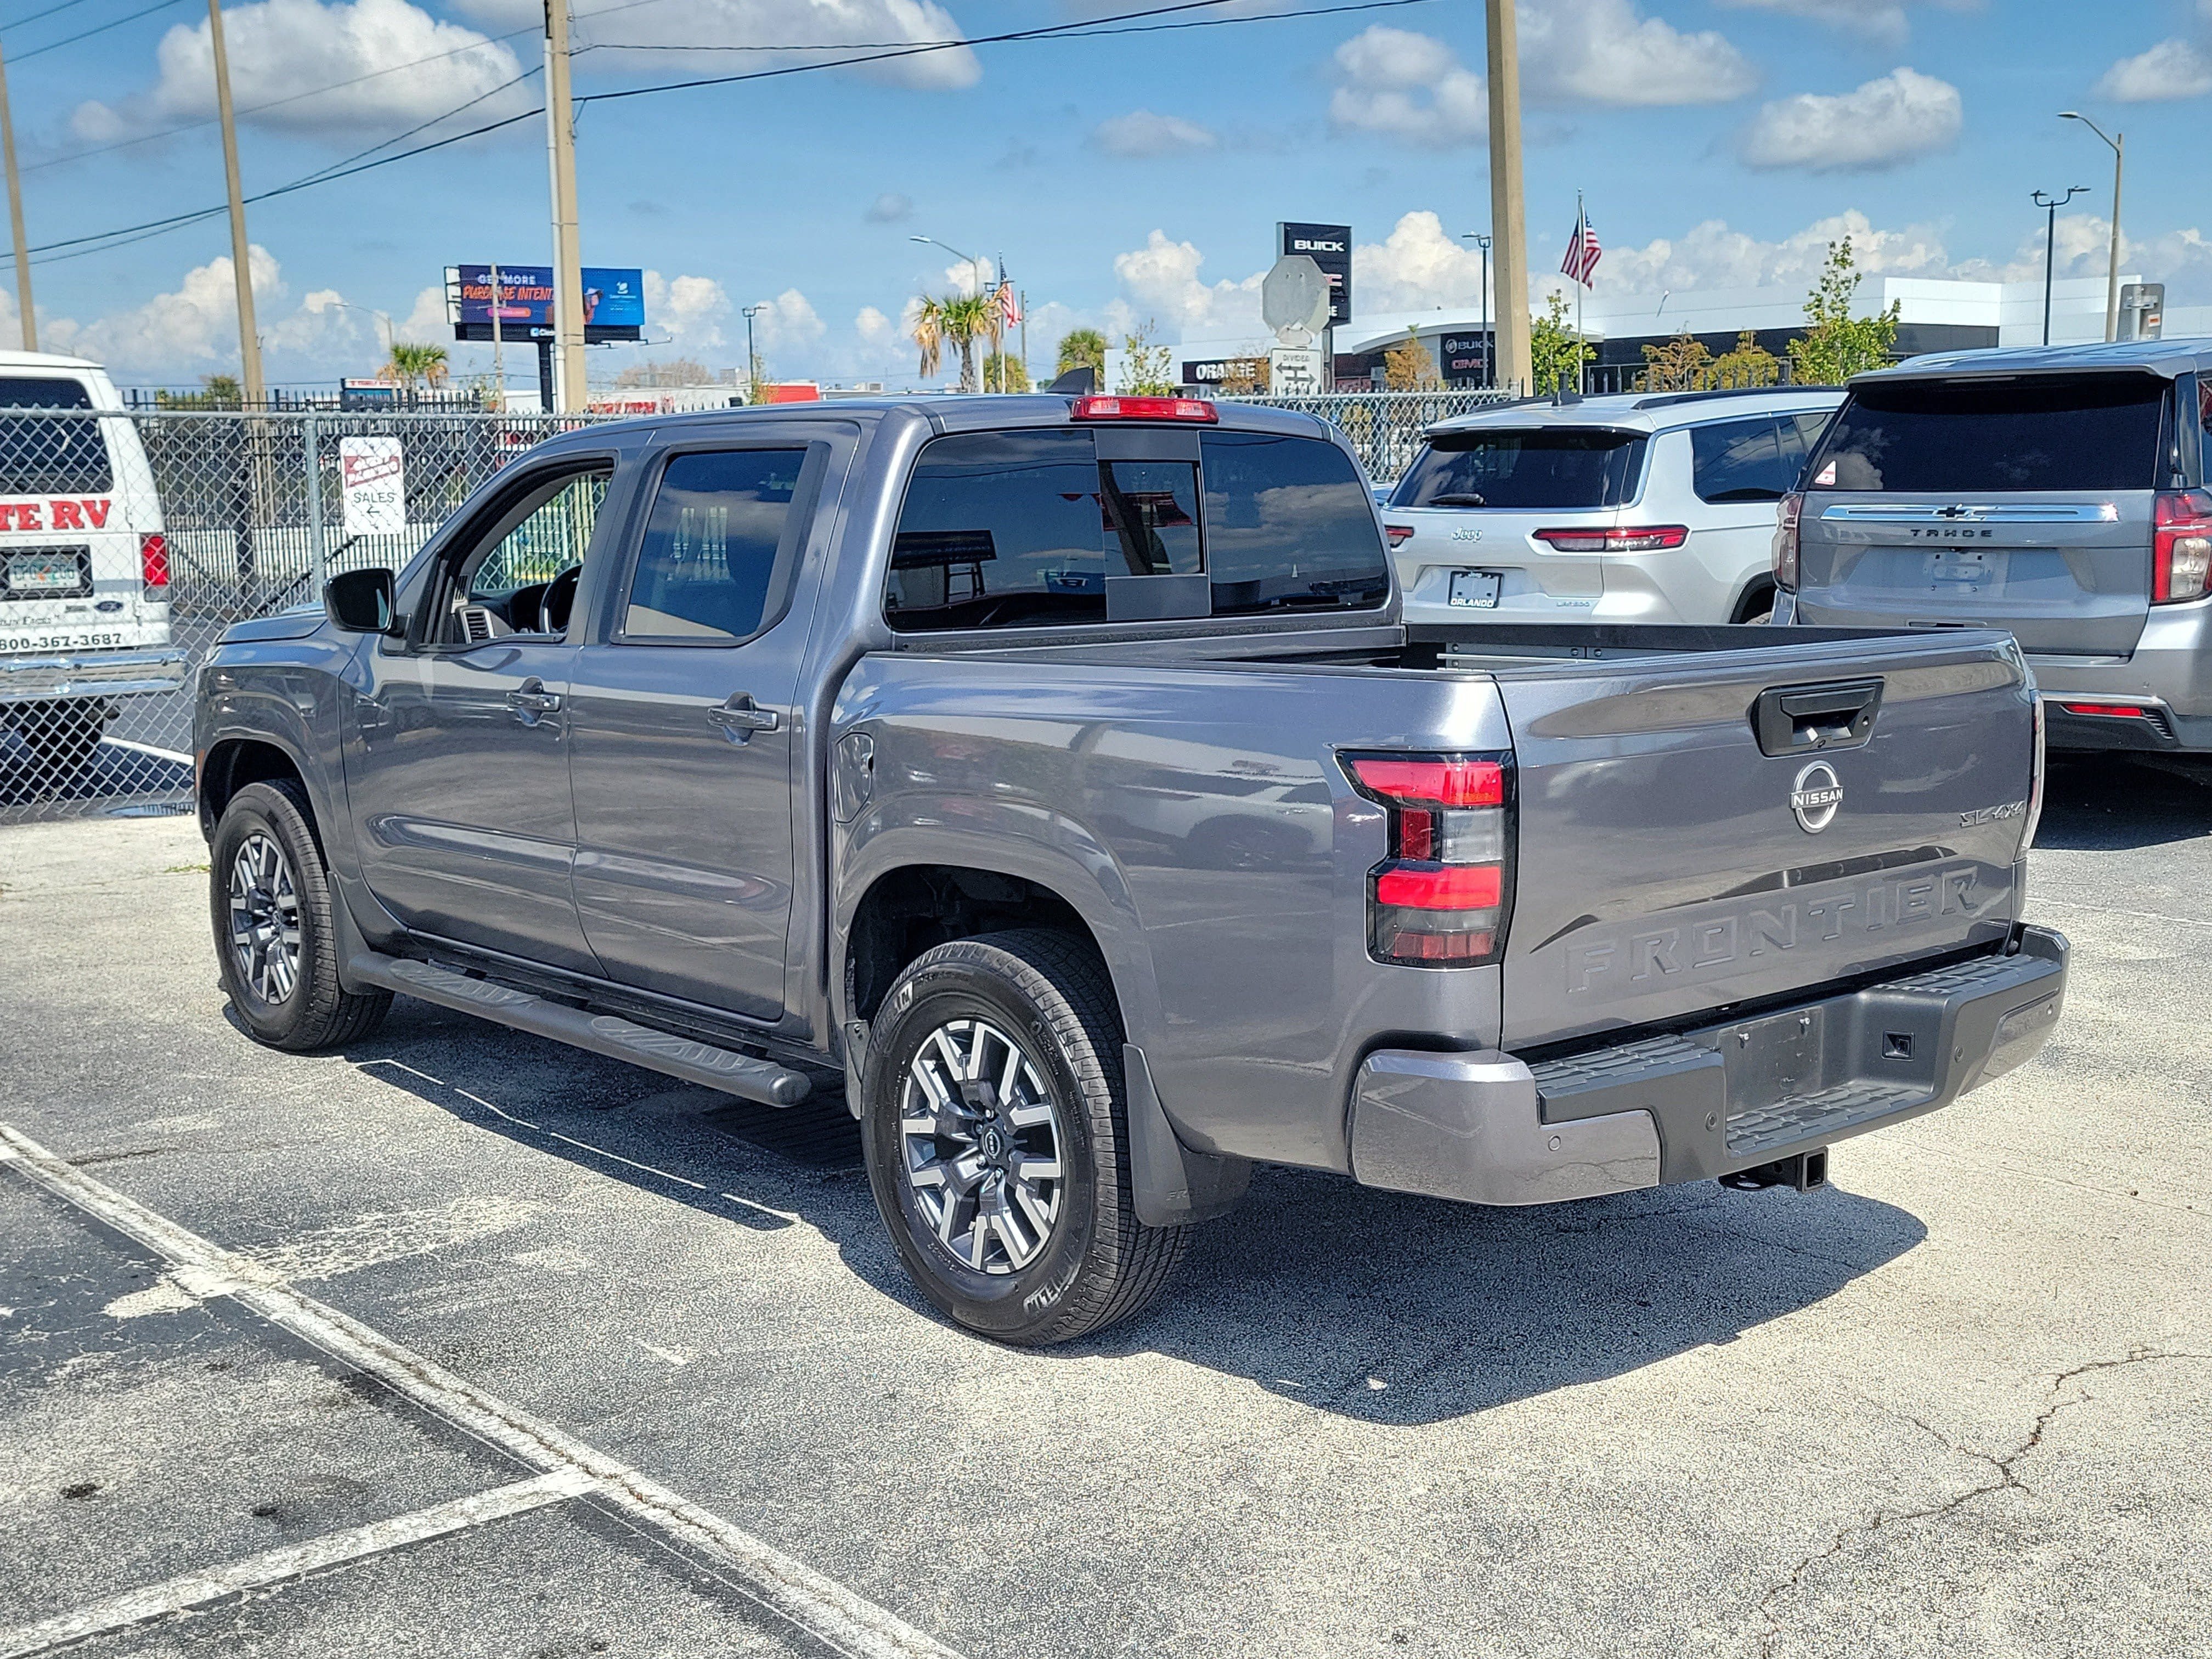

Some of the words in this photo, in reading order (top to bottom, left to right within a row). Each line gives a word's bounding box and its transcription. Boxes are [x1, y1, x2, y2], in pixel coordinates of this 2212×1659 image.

[1294, 239, 1345, 252] BUICK
[503, 274, 537, 285] MORE
[1195, 362, 1257, 380] ORANGE
[353, 492, 395, 503] SALES
[49, 499, 111, 529] RV
[1451, 527, 1483, 543] Jeep
[1910, 528, 1993, 537] TAHOE
[1450, 597, 1494, 608] ORLANDO
[1793, 788, 1843, 806] NISSAN
[1959, 809, 1990, 828] SL
[1564, 865, 1980, 995] FRONTIER
